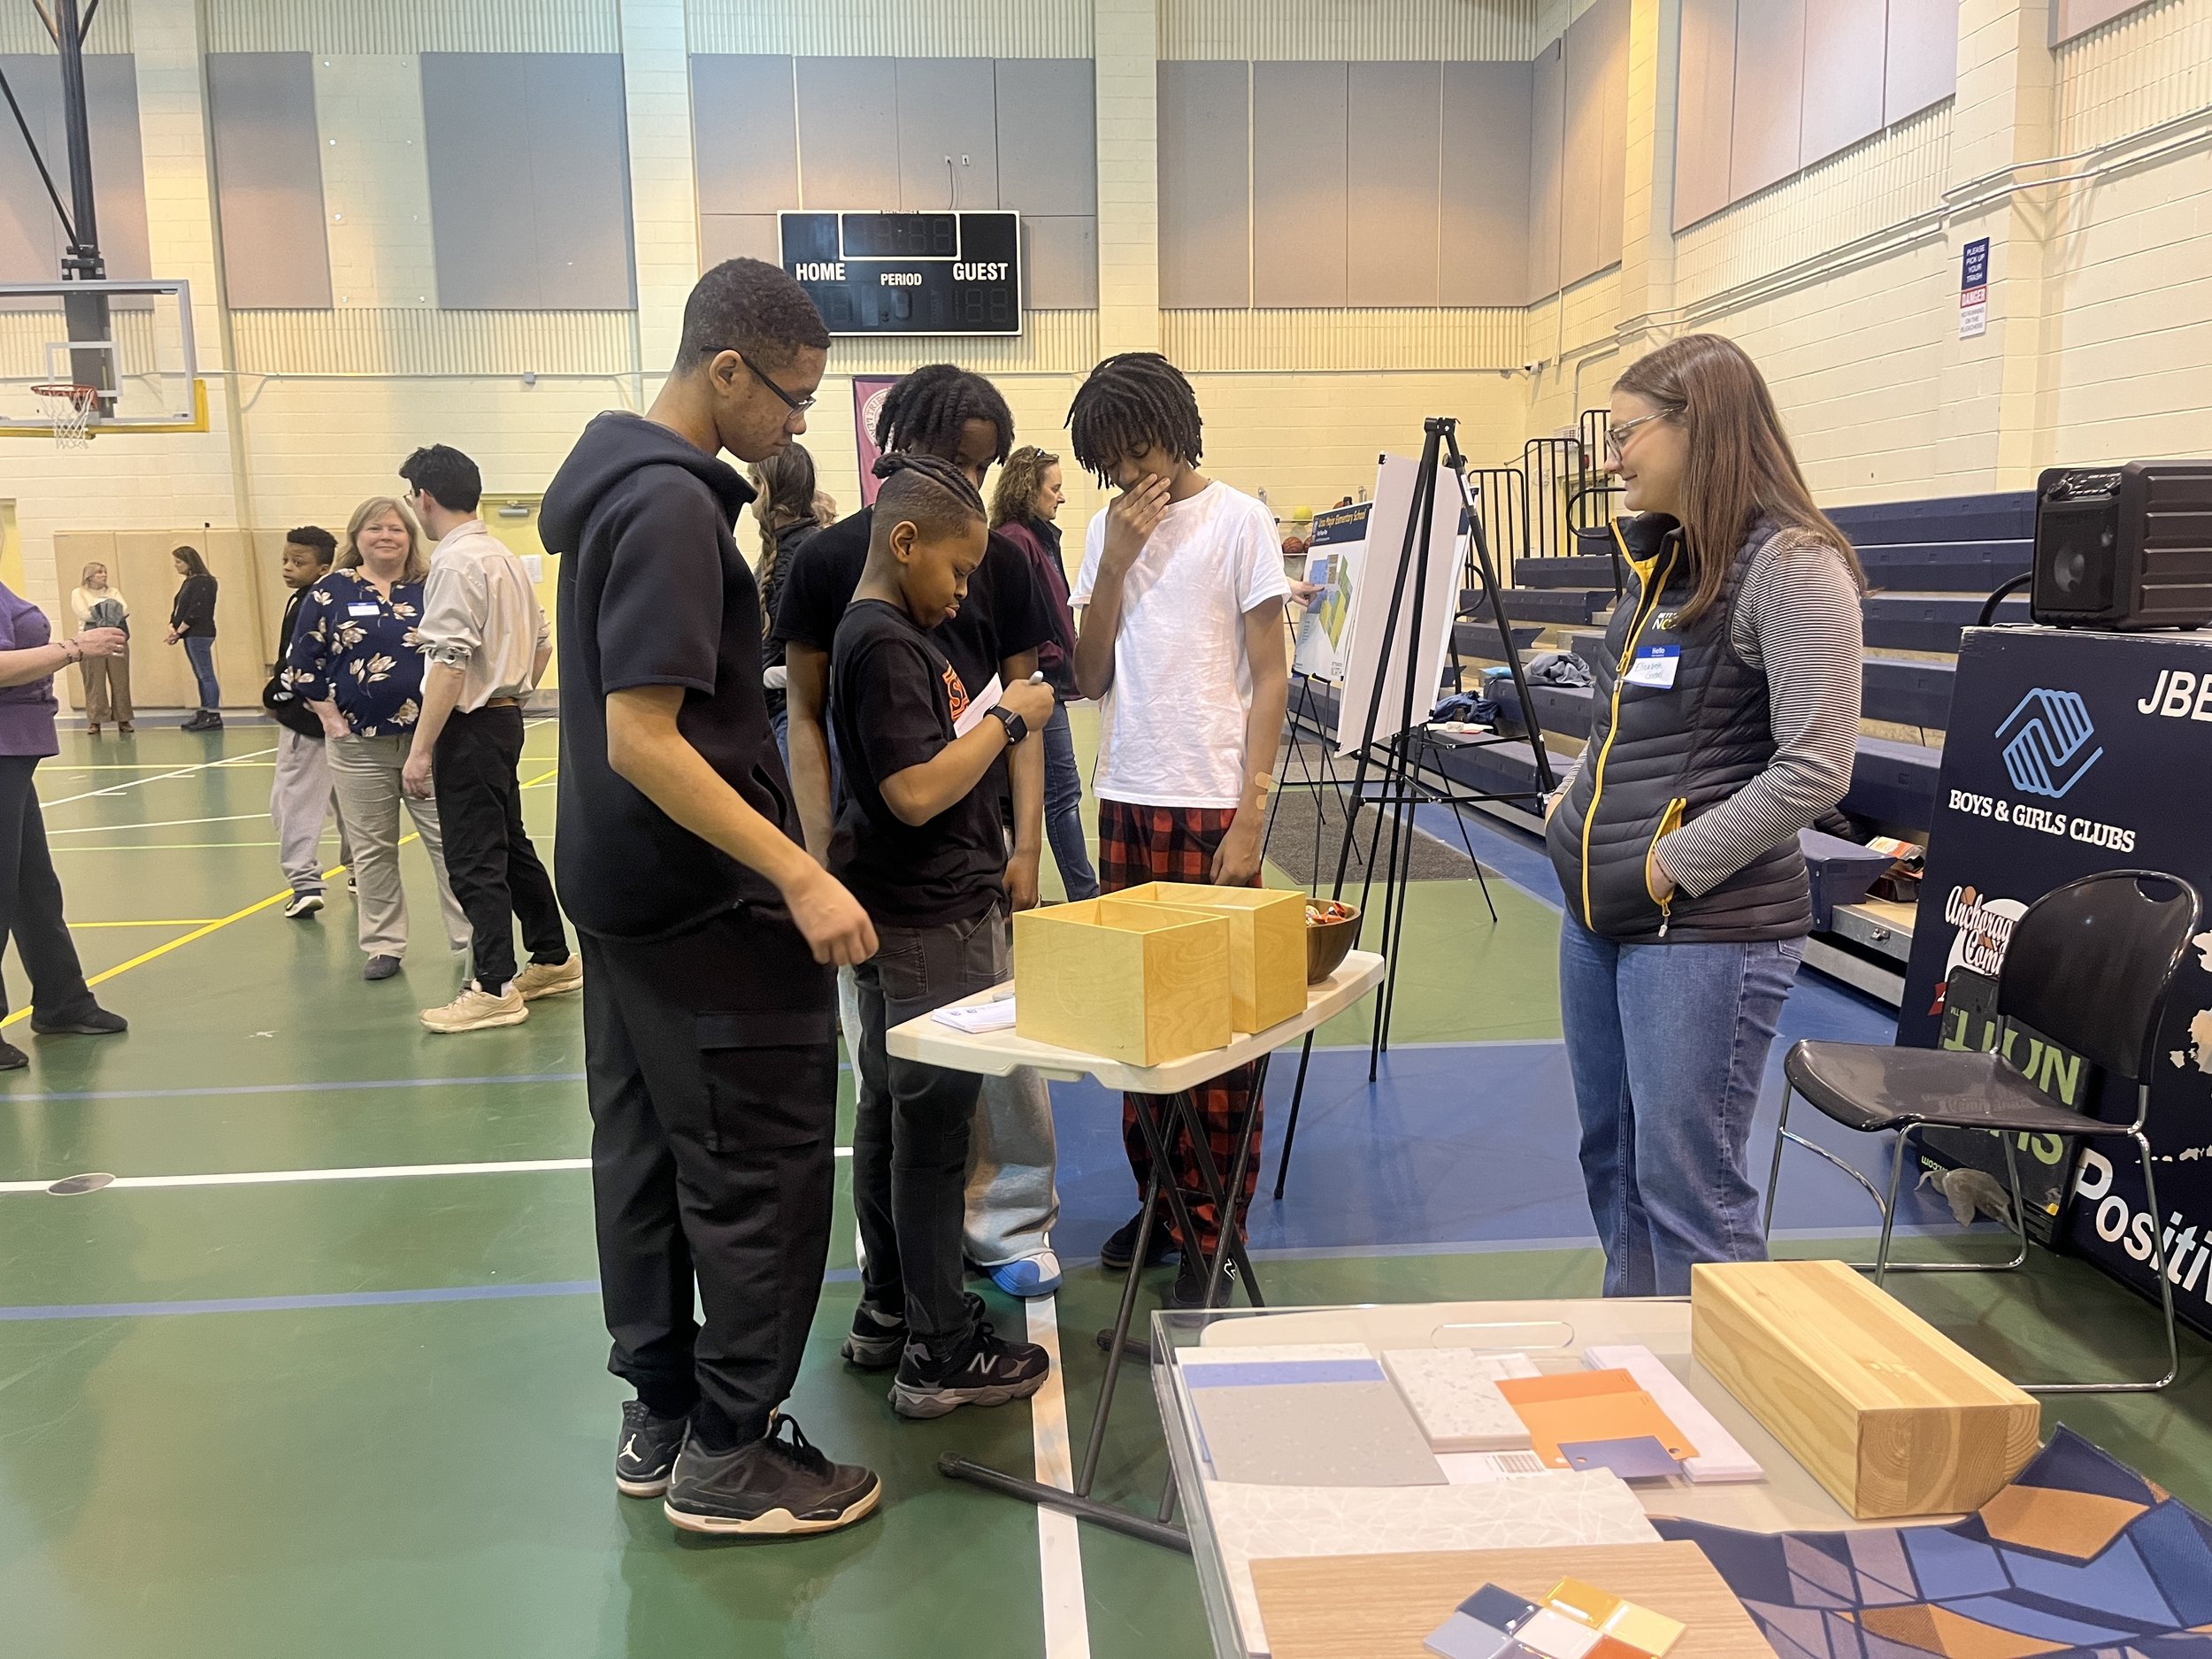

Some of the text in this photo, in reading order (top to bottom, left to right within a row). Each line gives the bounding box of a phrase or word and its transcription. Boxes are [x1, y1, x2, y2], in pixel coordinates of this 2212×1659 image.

[1966, 244, 1985, 257] PLEASE
[1966, 253, 1985, 265] PICK UP
[796, 263, 846, 281] HOME
[953, 263, 1009, 281] GUEST
[1968, 263, 1982, 273] YOUR
[880, 273, 922, 286] PERIOD
[1948, 789, 2136, 853] BOYS & GIRLS CLUBS
[1945, 886, 2014, 953] Anchorag
[2068, 1147, 2212, 1305] Positi
